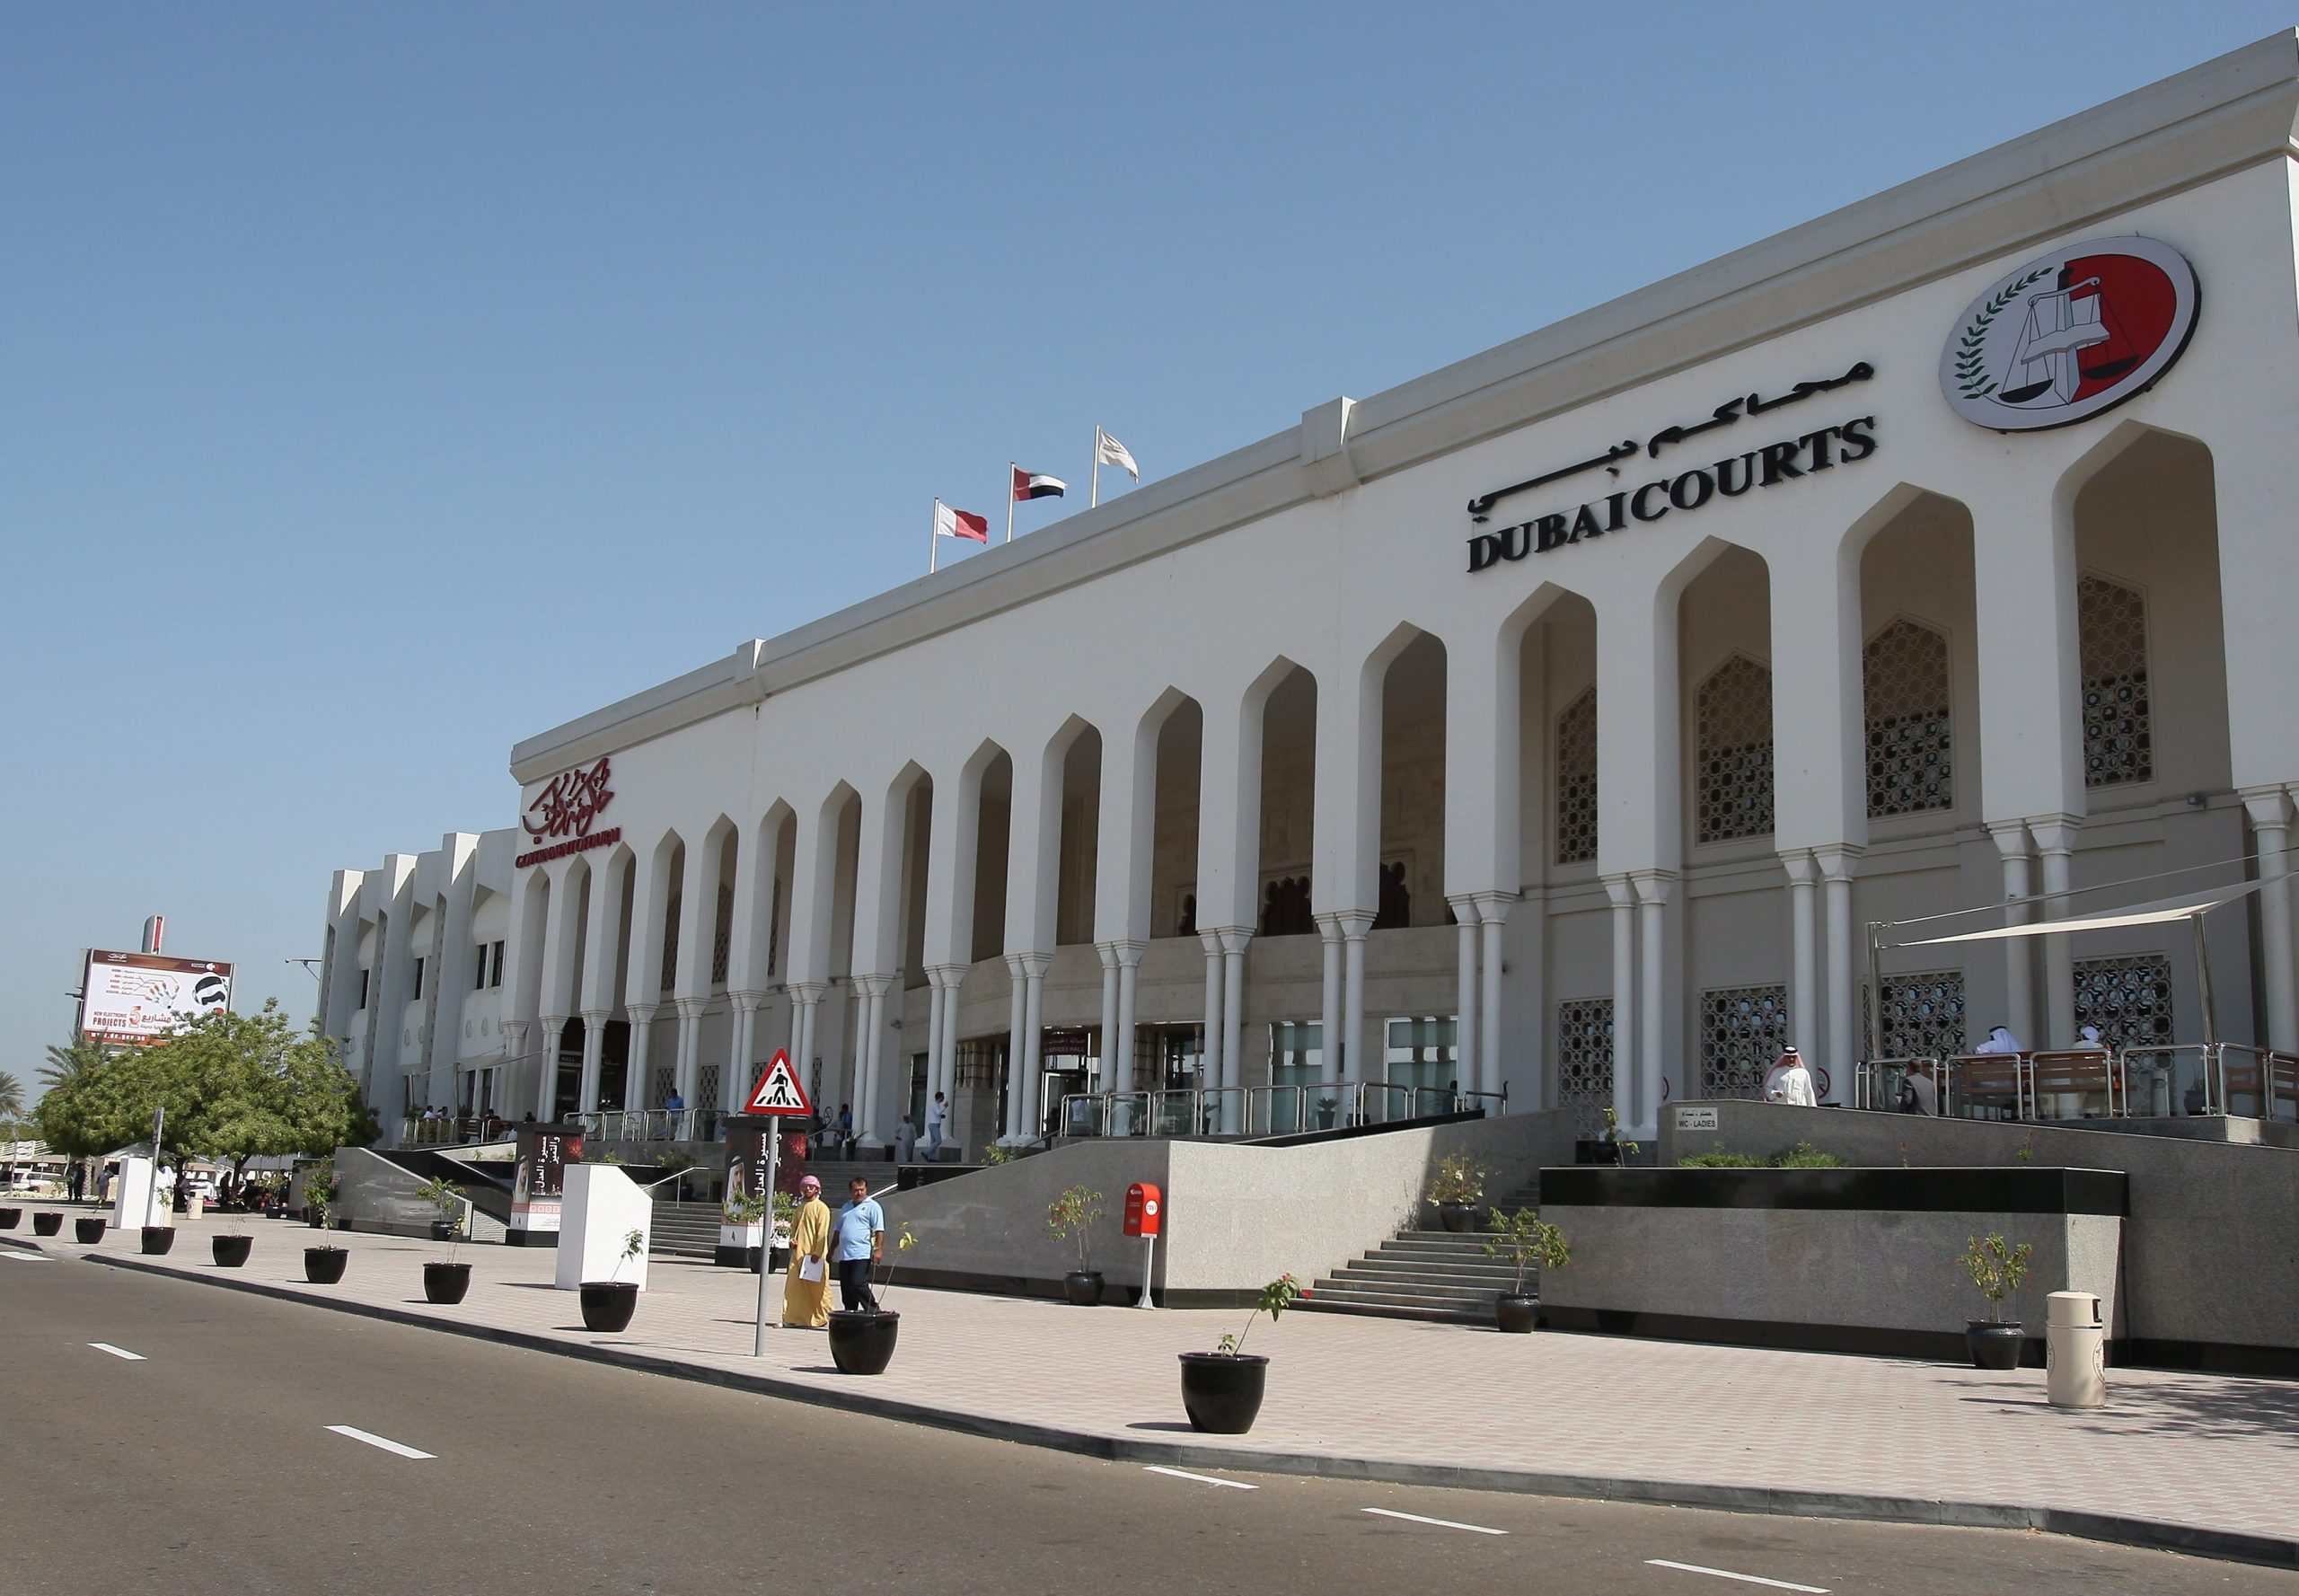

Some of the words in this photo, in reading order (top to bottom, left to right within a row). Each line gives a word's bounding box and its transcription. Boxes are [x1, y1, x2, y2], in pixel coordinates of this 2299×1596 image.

[1647, 362, 1874, 458] محاكم
[1467, 440, 1638, 523] دبي
[1467, 491, 1626, 573] DUBAI
[1630, 415, 1879, 523] COURTS
[92, 1018, 127, 1027] PROJECTS
[129, 1006, 141, 1025] 5
[141, 1013, 172, 1023] مشاريع
[537, 1136, 549, 1163] مسيرة
[756, 1133, 769, 1165] مسيرة
[535, 1165, 546, 1188] العدل
[753, 1168, 765, 1196] العدل
